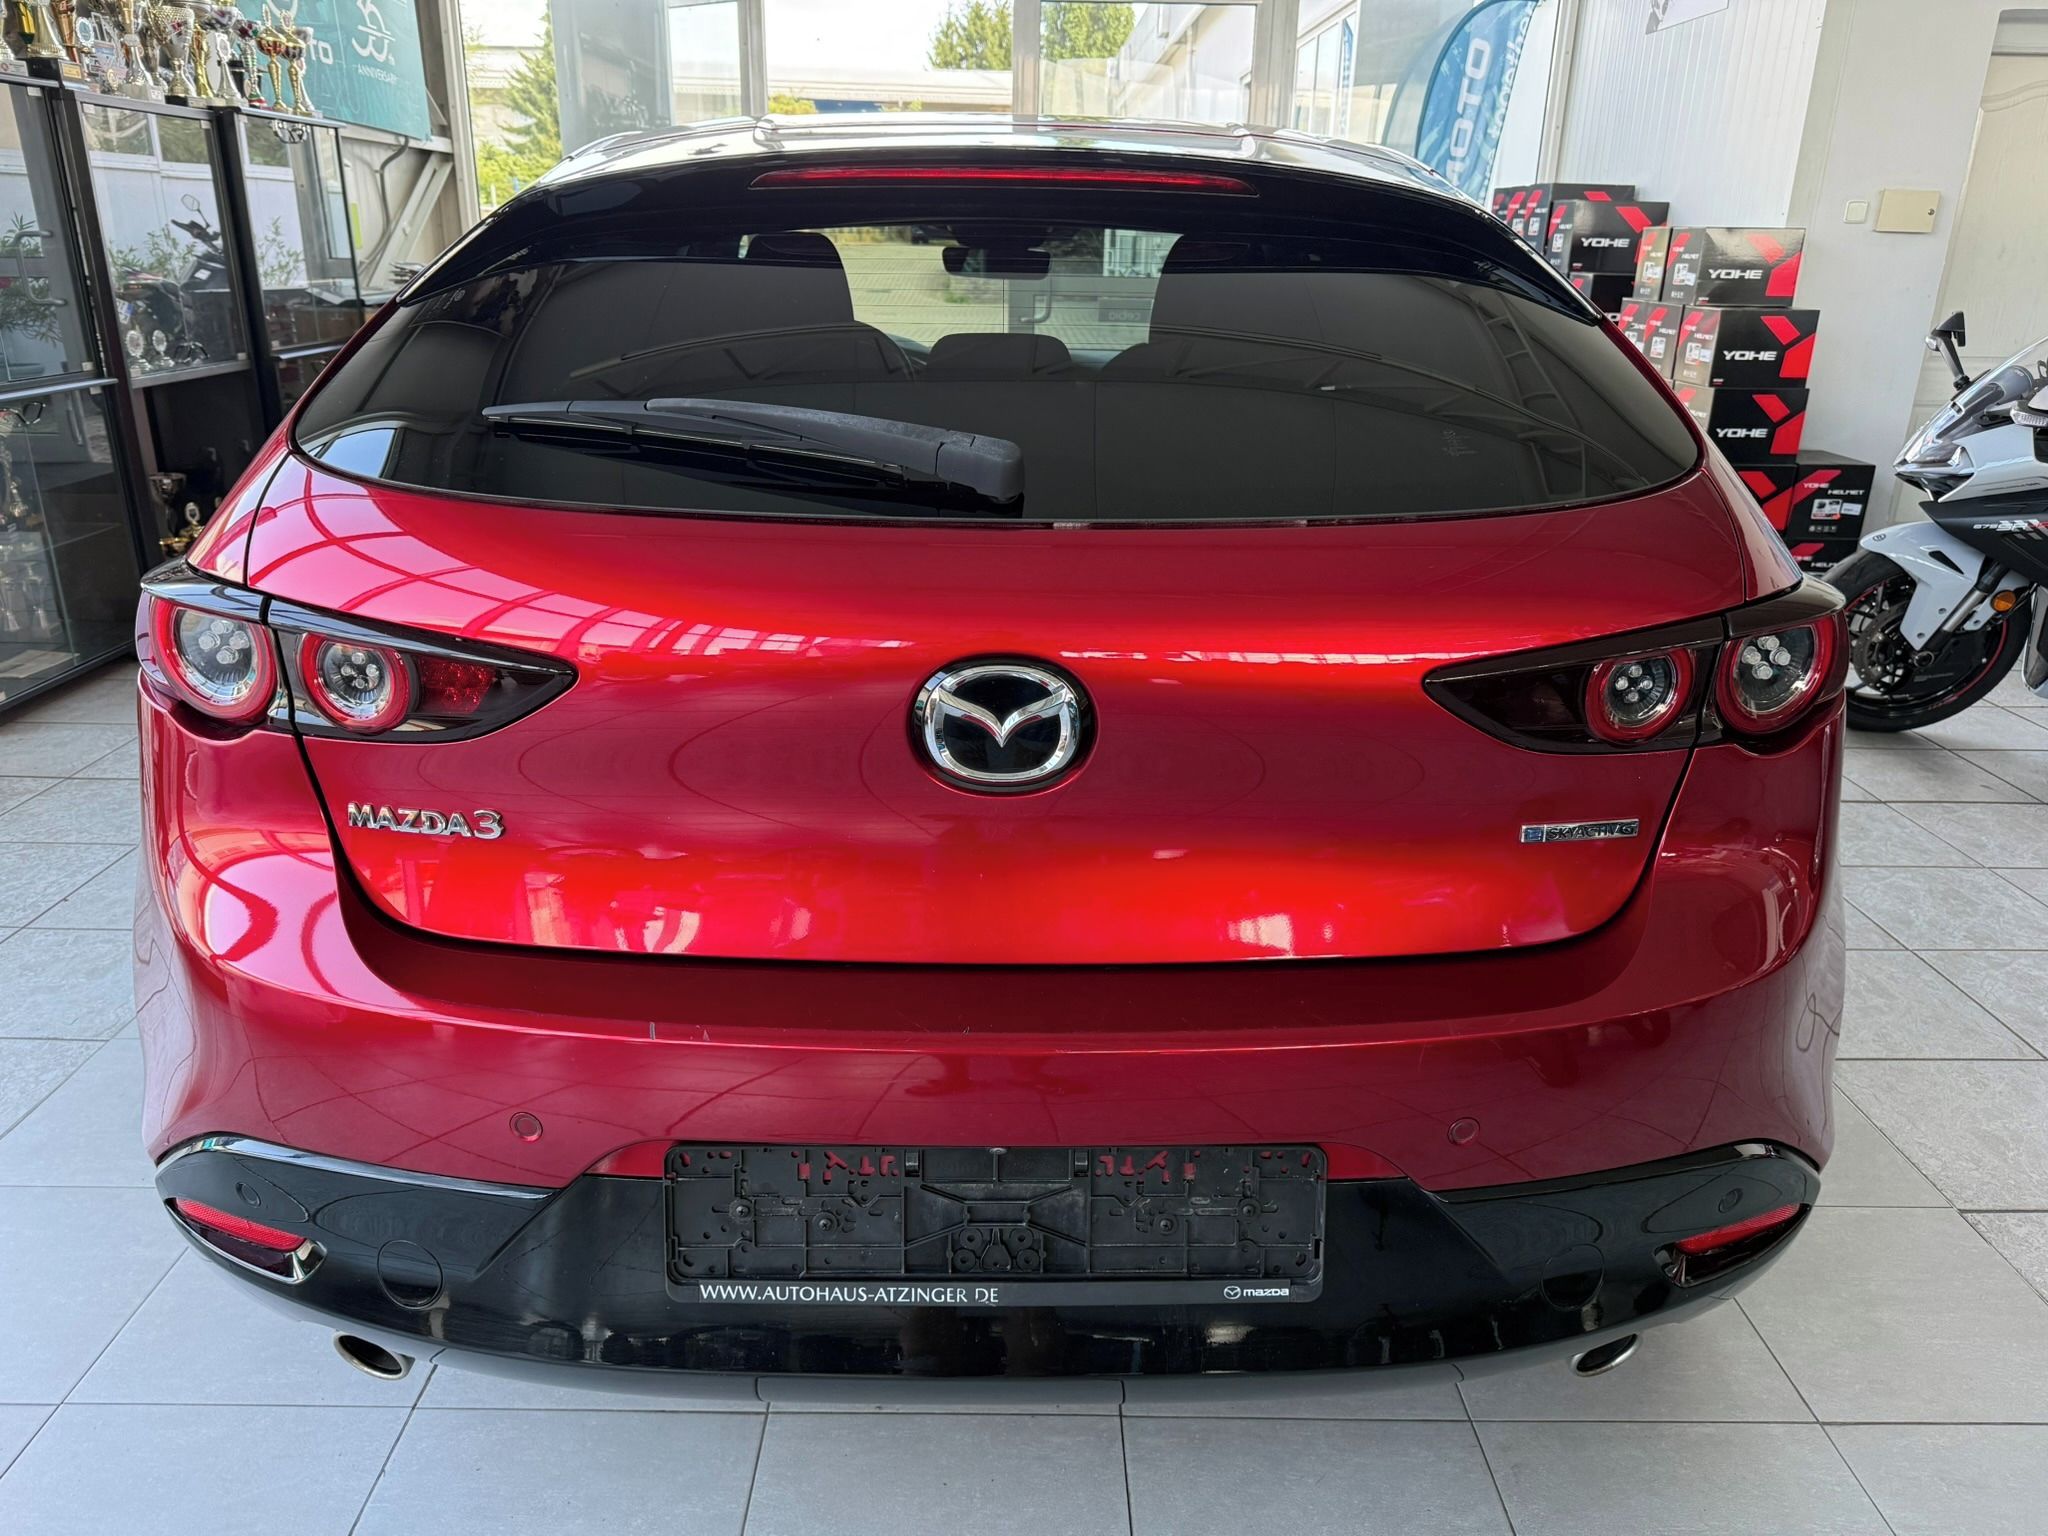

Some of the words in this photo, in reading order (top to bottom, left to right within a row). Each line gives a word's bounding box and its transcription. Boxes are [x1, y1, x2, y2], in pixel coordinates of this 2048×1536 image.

[1580, 237, 1630, 248] YOHE
[1708, 268, 1763, 280] YOHE
[1722, 350, 1778, 361] YOHE
[1715, 427, 1769, 438] YOHE
[1243, 1288, 1290, 1297] mazda
